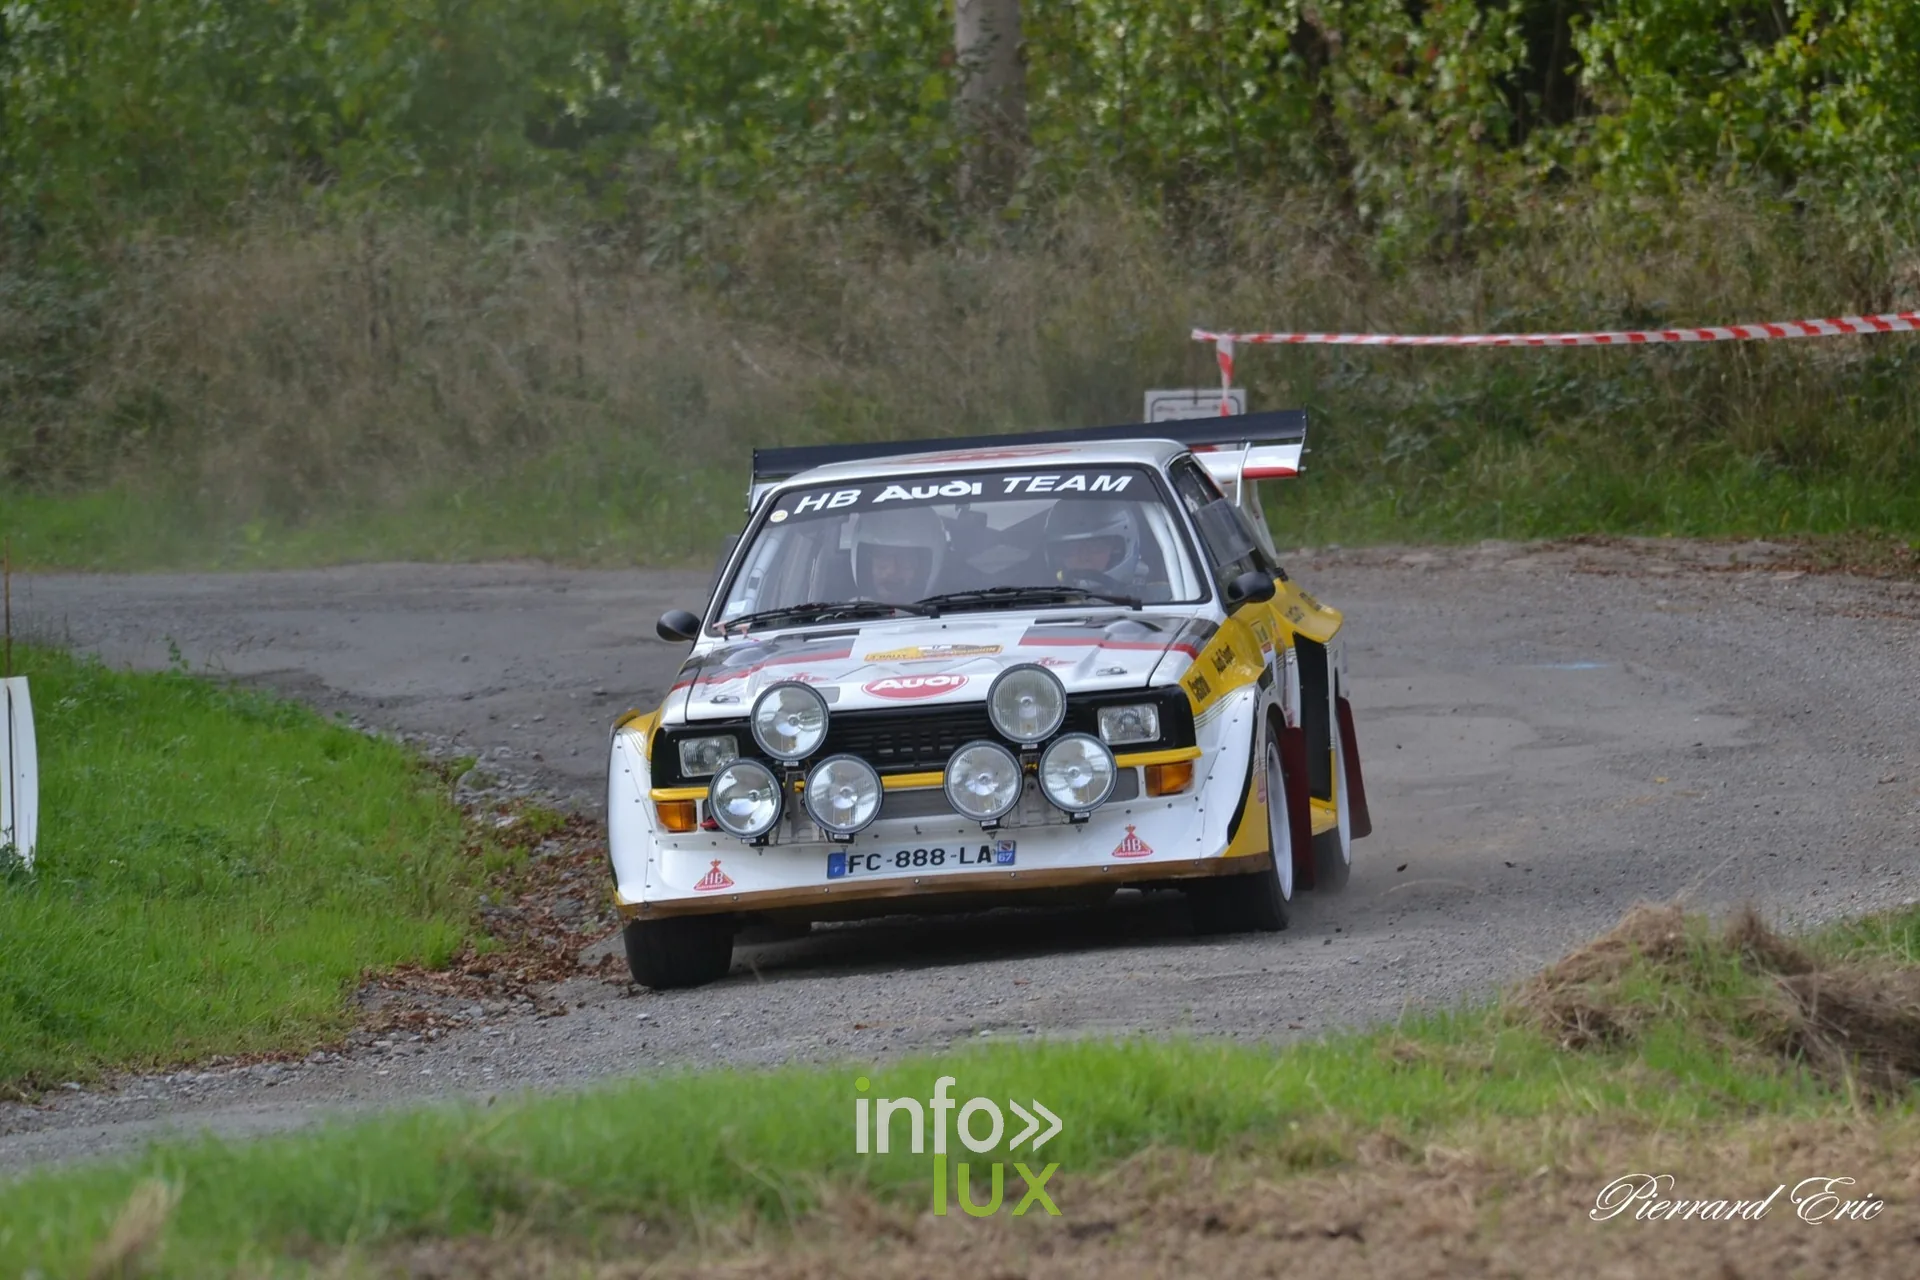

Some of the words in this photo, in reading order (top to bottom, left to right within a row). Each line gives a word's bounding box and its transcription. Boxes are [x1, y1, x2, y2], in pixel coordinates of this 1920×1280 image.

[794, 489, 862, 514] HB
[1003, 475, 1133, 493] TEAM
[1121, 838, 1141, 852] HB
[848, 845, 992, 873] FC-888-LA
[998, 852, 1013, 863] 67
[704, 871, 724, 885] HB
